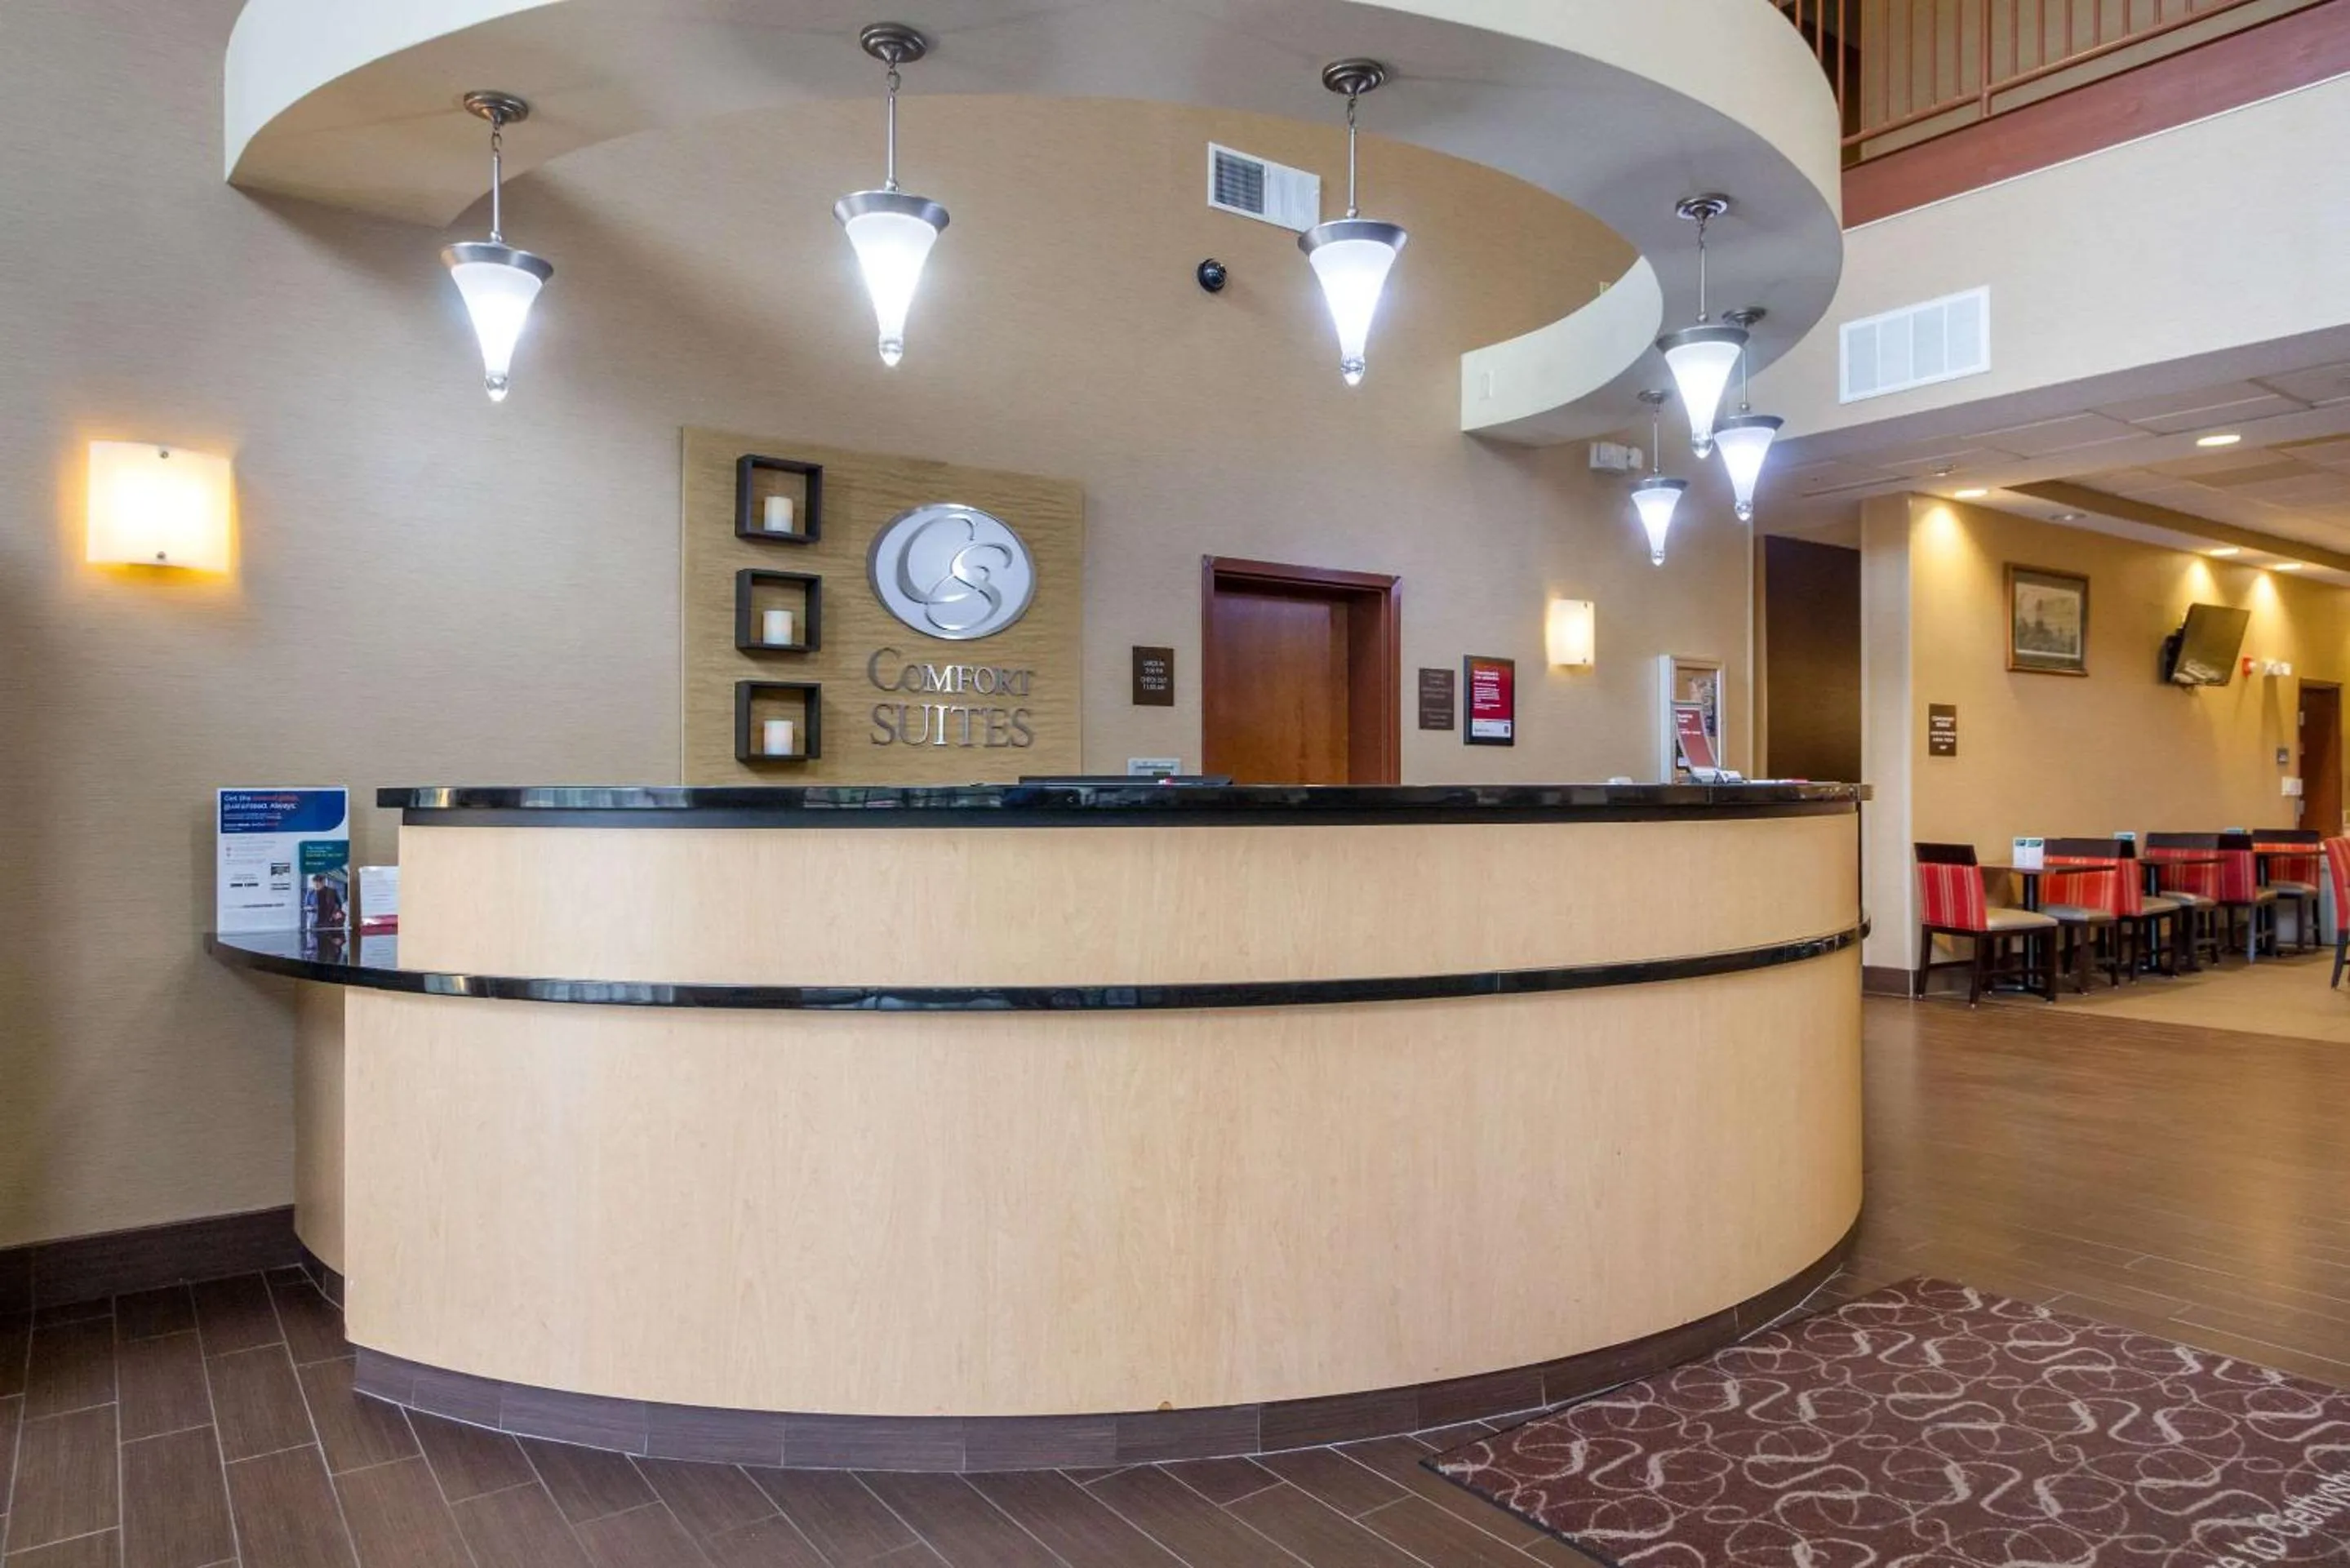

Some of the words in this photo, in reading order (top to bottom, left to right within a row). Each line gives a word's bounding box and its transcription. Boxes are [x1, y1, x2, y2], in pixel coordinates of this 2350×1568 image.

[867, 646, 1035, 696] COMFORT
[870, 703, 1035, 748] SUITES
[2223, 1535, 2287, 1561] to
[2255, 1469, 2350, 1538] Gettysb
